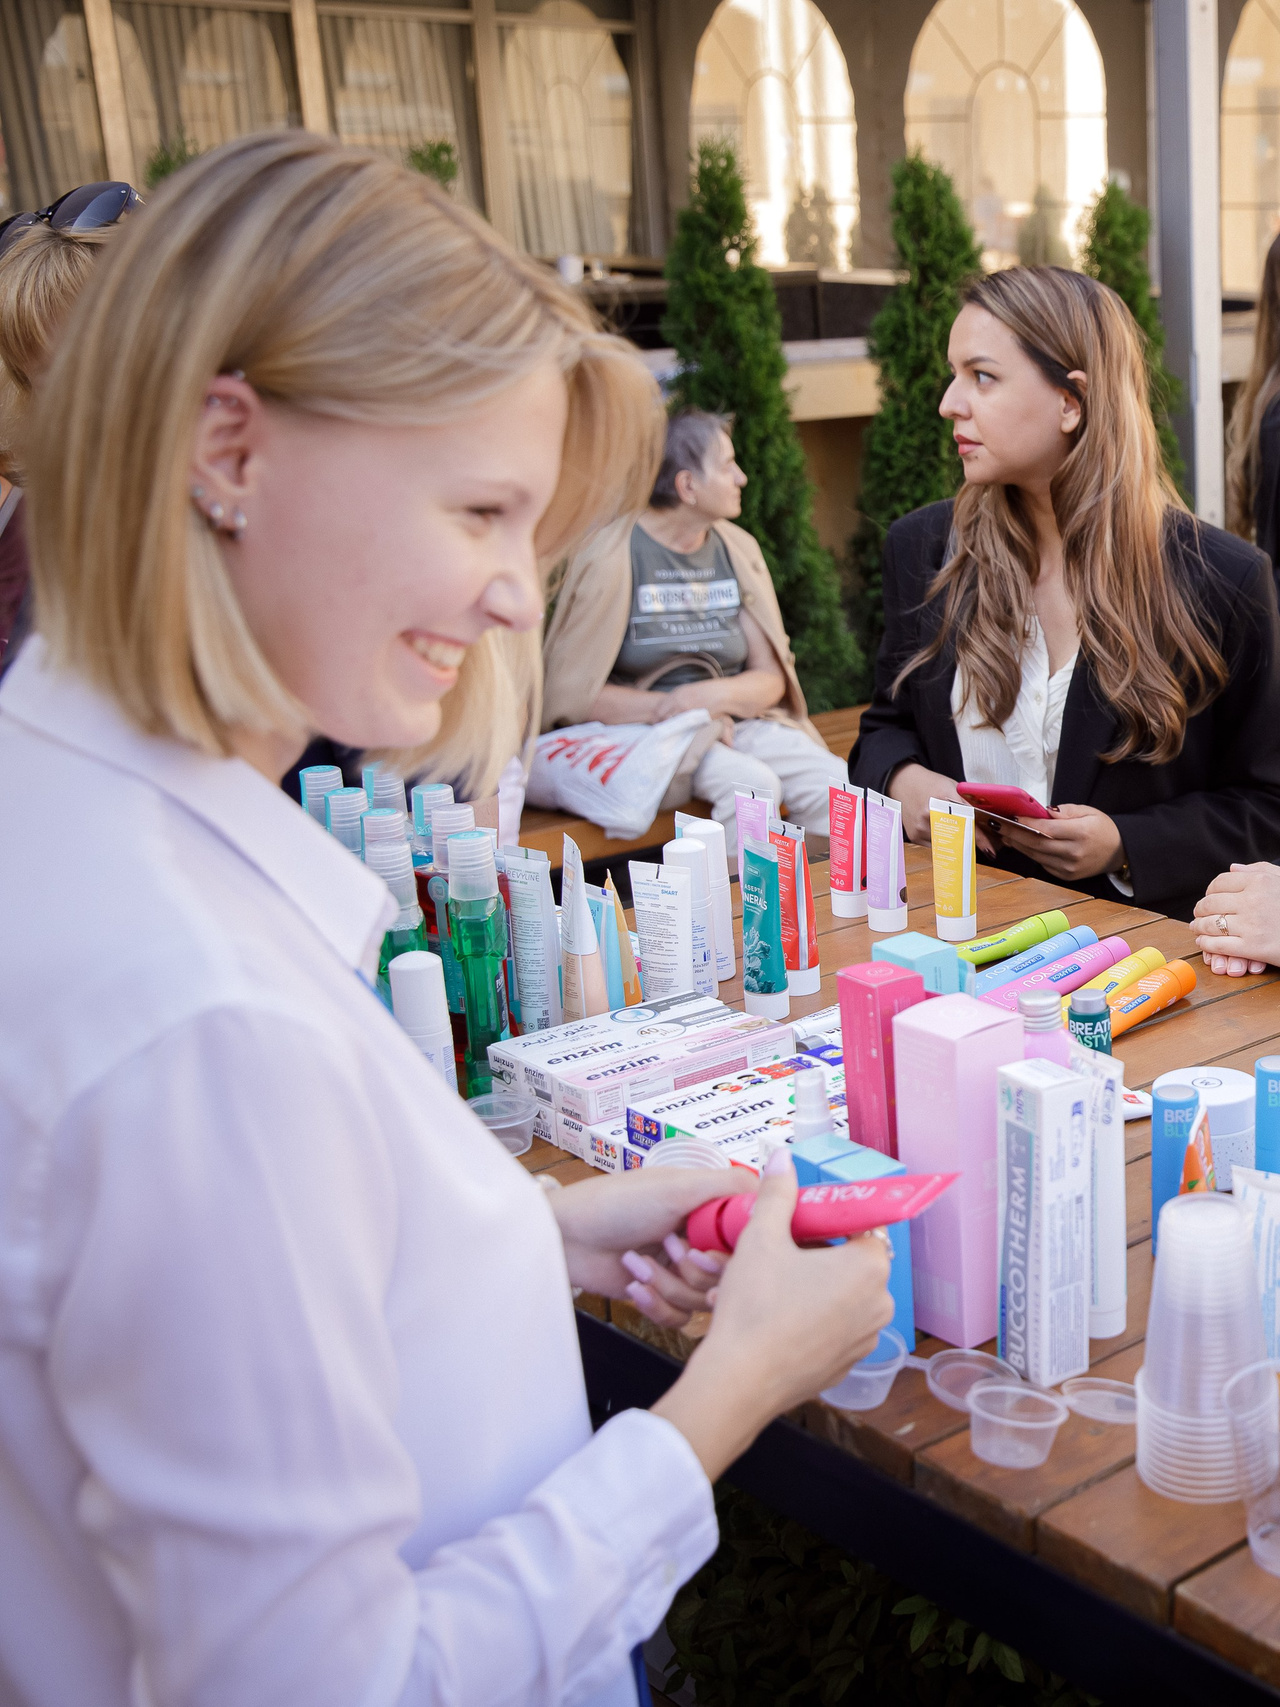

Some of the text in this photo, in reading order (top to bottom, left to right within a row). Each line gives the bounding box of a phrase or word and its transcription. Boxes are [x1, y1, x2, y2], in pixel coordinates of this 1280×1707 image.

[744, 883, 763, 895] ASEPTA
[743, 894, 768, 911] NERALS
[1012, 954, 1044, 972] CURAPROX
[1051, 964, 1079, 981] CURAPROX
[1120, 994, 1150, 1014] CURAPROX
[1074, 1033, 1107, 1048] ASTY
[547, 1040, 623, 1065] enzim
[493, 1055, 515, 1069] enzim
[586, 1054, 660, 1081] enzim
[524, 1066, 545, 1080] enzim
[652, 1090, 716, 1114] enzim
[561, 1106, 582, 1120] enzim
[694, 1099, 775, 1130] enzim
[563, 1117, 583, 1132] enzim
[1164, 1121, 1191, 1138] BLU
[713, 1125, 769, 1147] enzim
[594, 1155, 616, 1170] enzim
[800, 1186, 877, 1204] BE YOU
[1007, 1167, 1028, 1371] BUCCOTHERM
